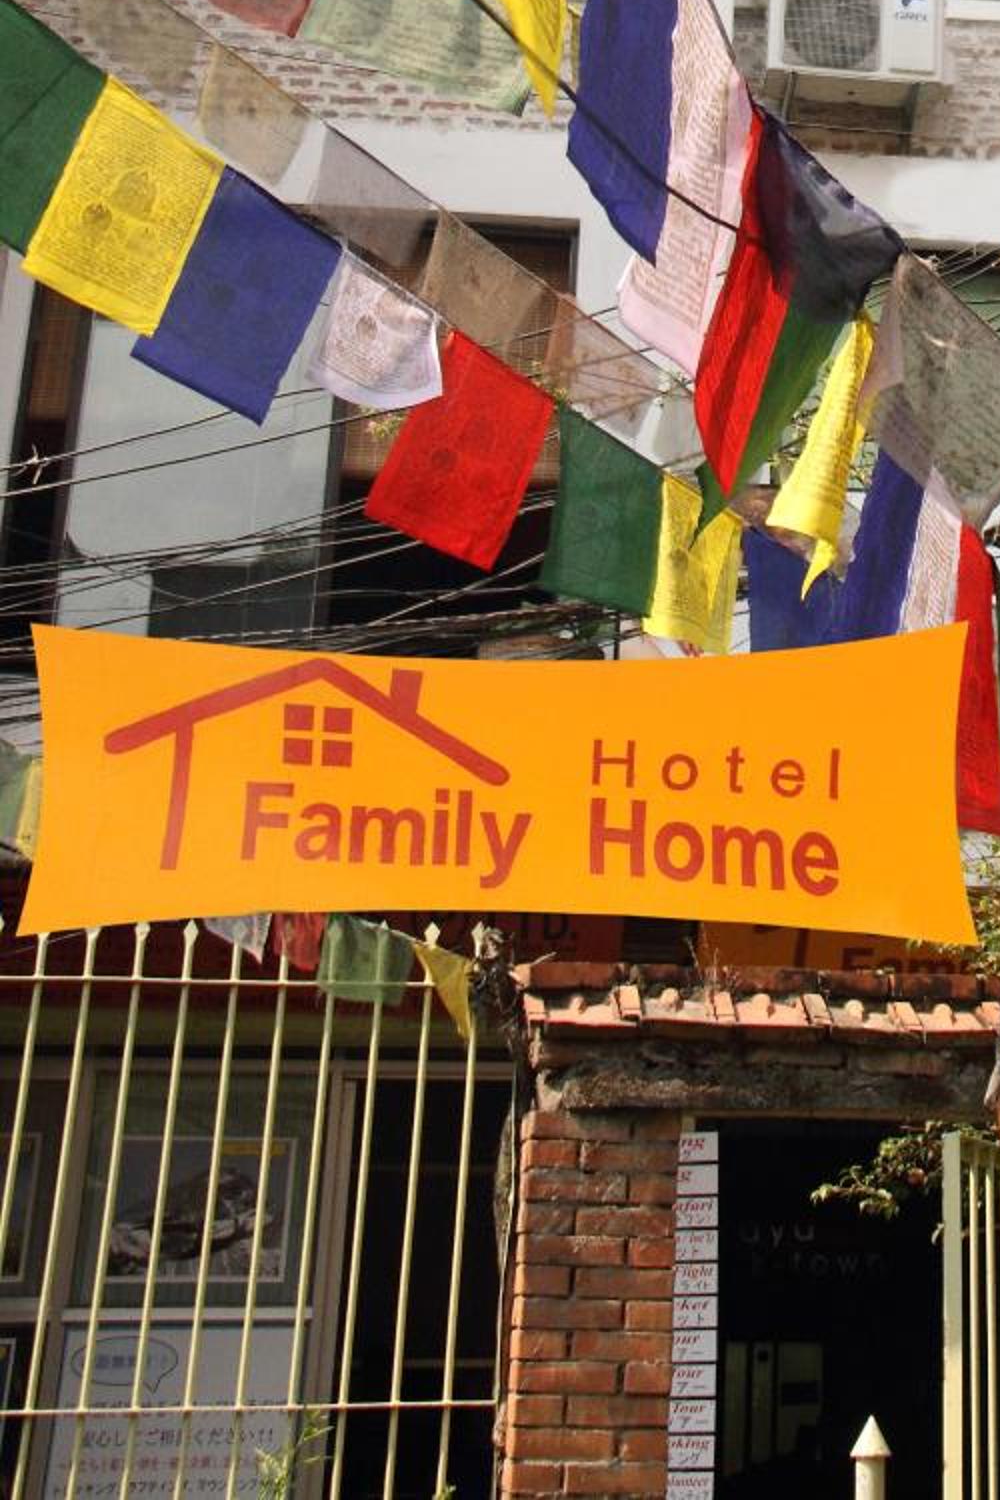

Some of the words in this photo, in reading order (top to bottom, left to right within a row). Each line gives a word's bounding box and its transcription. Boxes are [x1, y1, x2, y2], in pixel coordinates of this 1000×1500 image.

[591, 739, 840, 800] Hotel
[240, 780, 532, 889] Family
[589, 797, 840, 897] Home
